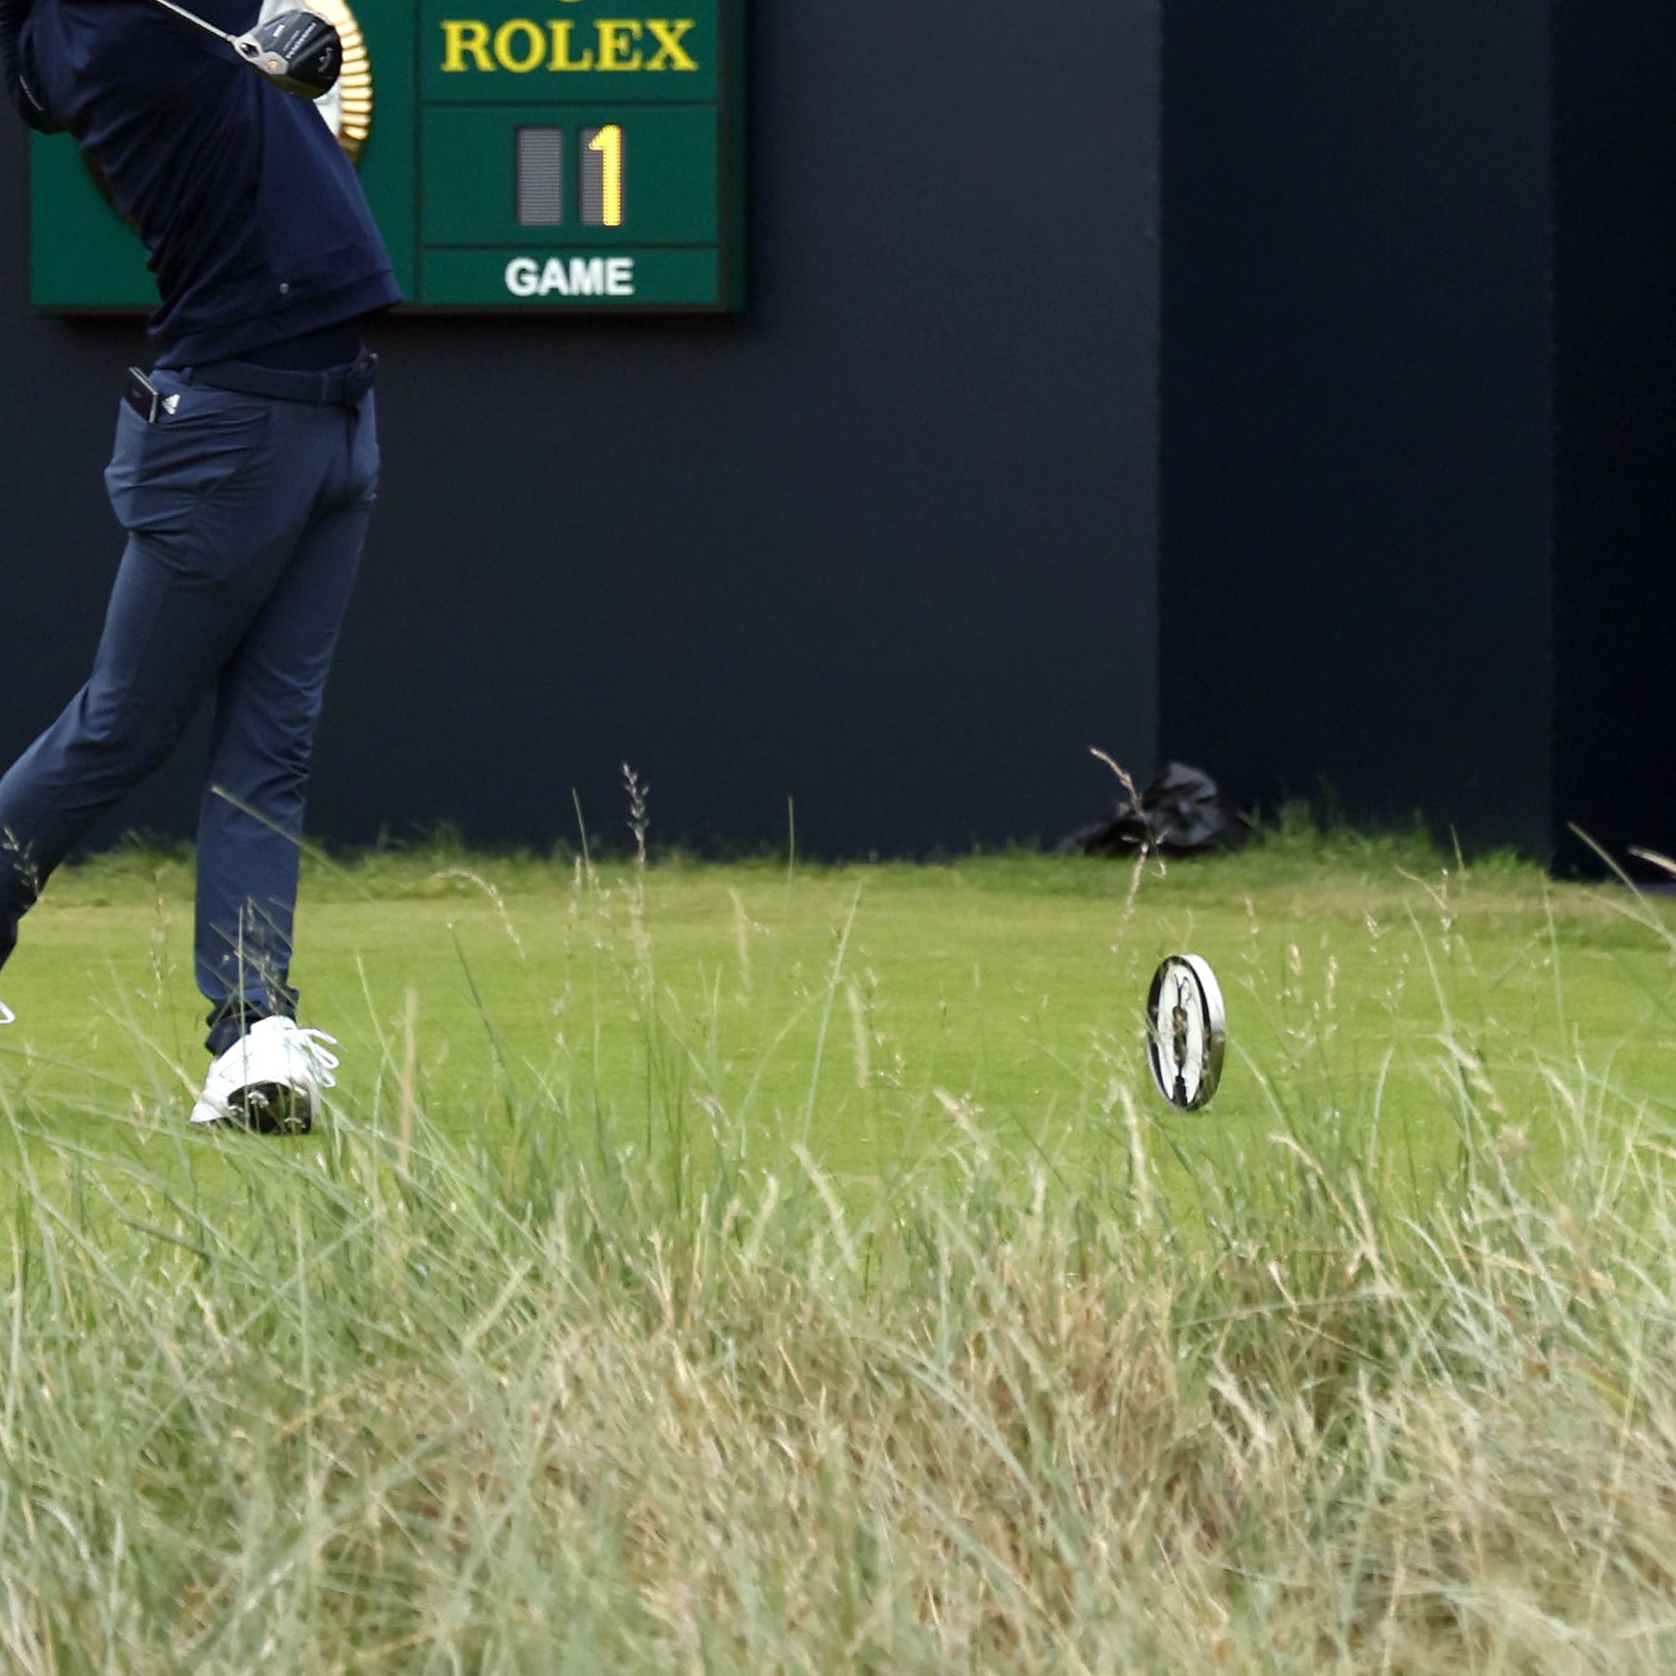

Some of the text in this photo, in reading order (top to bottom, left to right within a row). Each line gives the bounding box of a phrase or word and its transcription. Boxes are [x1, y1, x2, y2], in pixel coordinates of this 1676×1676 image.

[440, 18, 699, 73] ROLEX
[588, 123, 622, 227] 1
[505, 256, 635, 298] GAME
